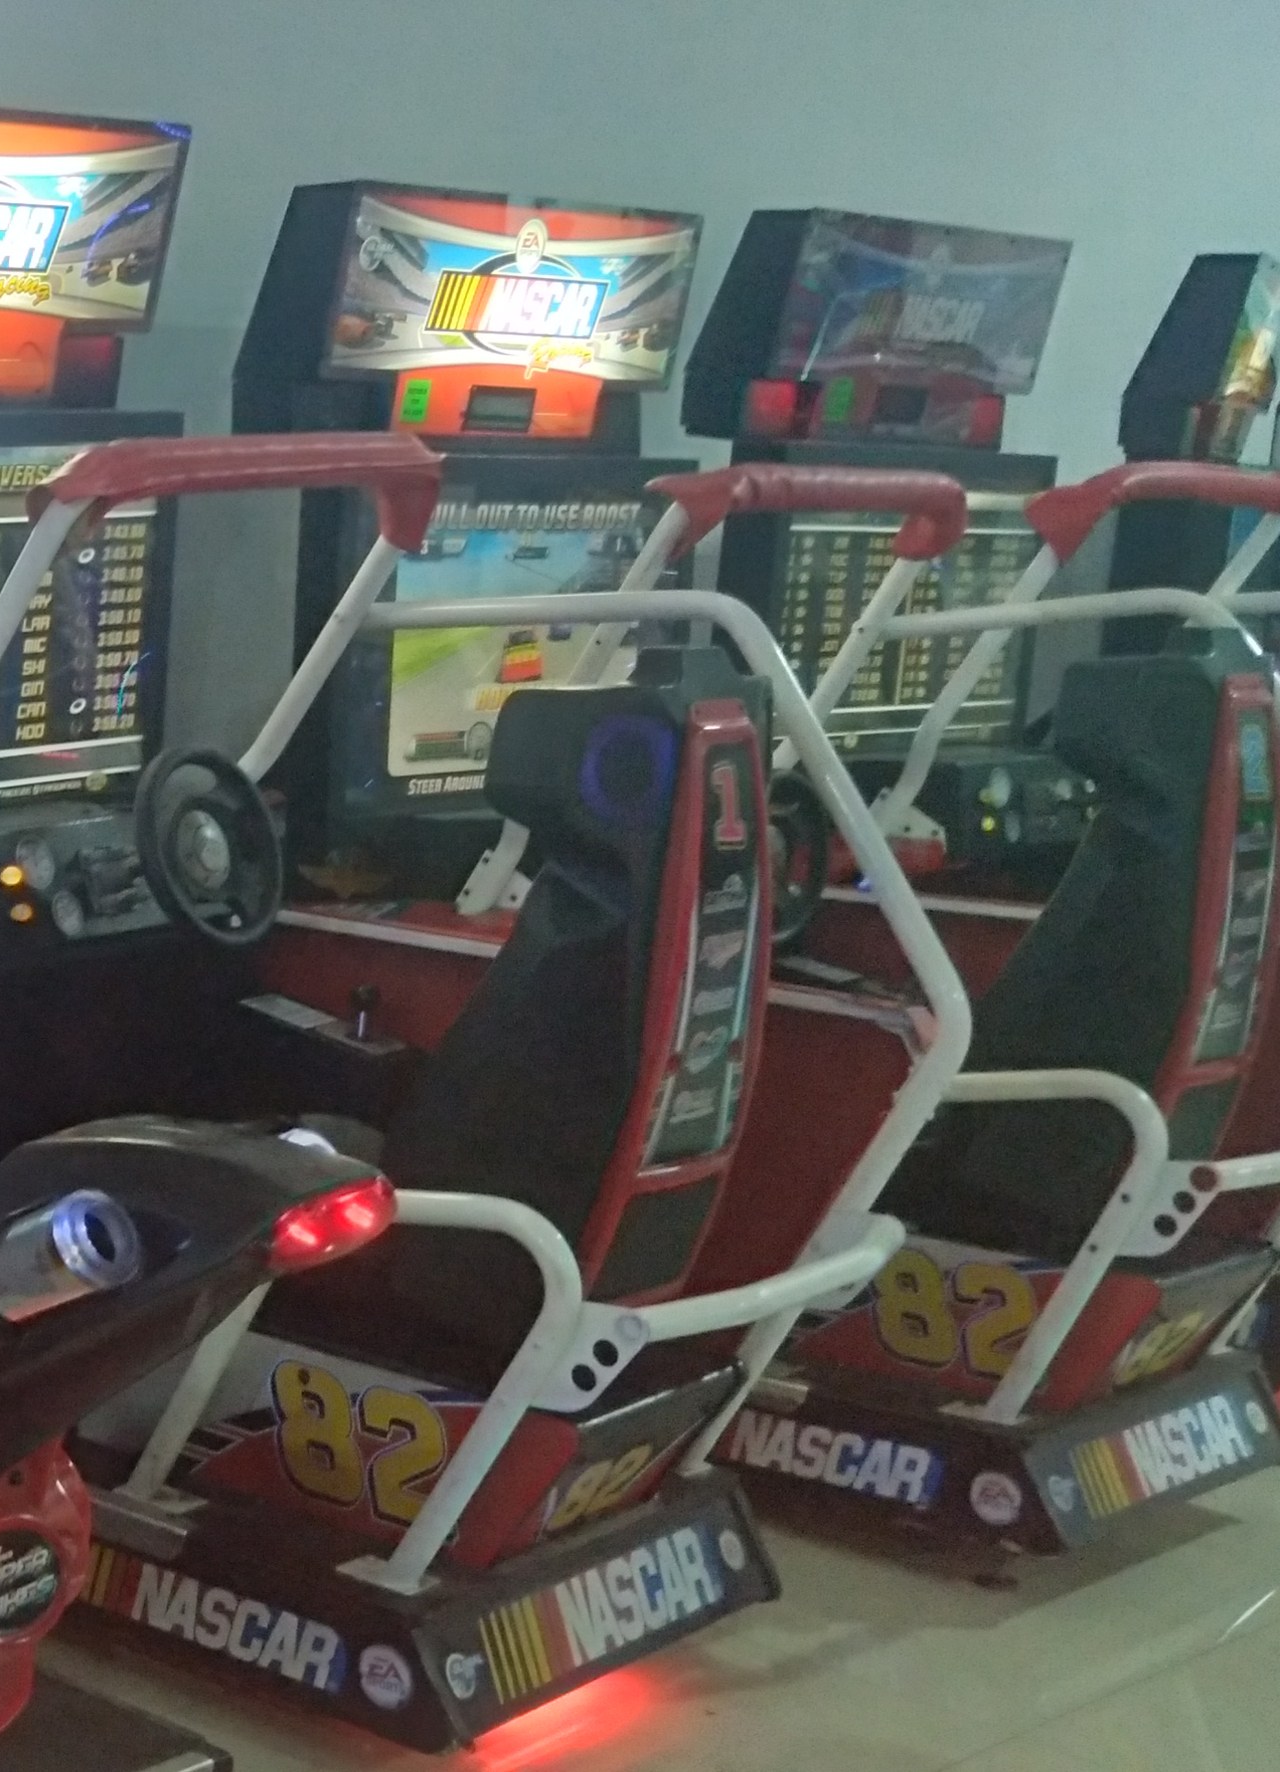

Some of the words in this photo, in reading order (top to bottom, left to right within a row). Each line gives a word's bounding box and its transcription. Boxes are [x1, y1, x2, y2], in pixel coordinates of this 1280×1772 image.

[521, 231, 539, 248] EA
[478, 276, 598, 336] NASCAR
[431, 504, 471, 529] ULL
[475, 504, 514, 530] OUT
[515, 504, 540, 530] TO
[543, 503, 580, 530] USE
[582, 503, 642, 530] BOOST
[17, 701, 47, 719] CAN
[408, 778, 443, 796] STEER
[710, 760, 747, 851] 1
[870, 1247, 1040, 1380] 82
[267, 1358, 448, 1528] 82
[727, 1408, 933, 1503] NASCAR
[1122, 1394, 1253, 1498] NASCAR
[130, 1561, 340, 1692] NASCAR
[556, 1525, 717, 1667] NASCAR
[366, 1660, 404, 1685] EA
